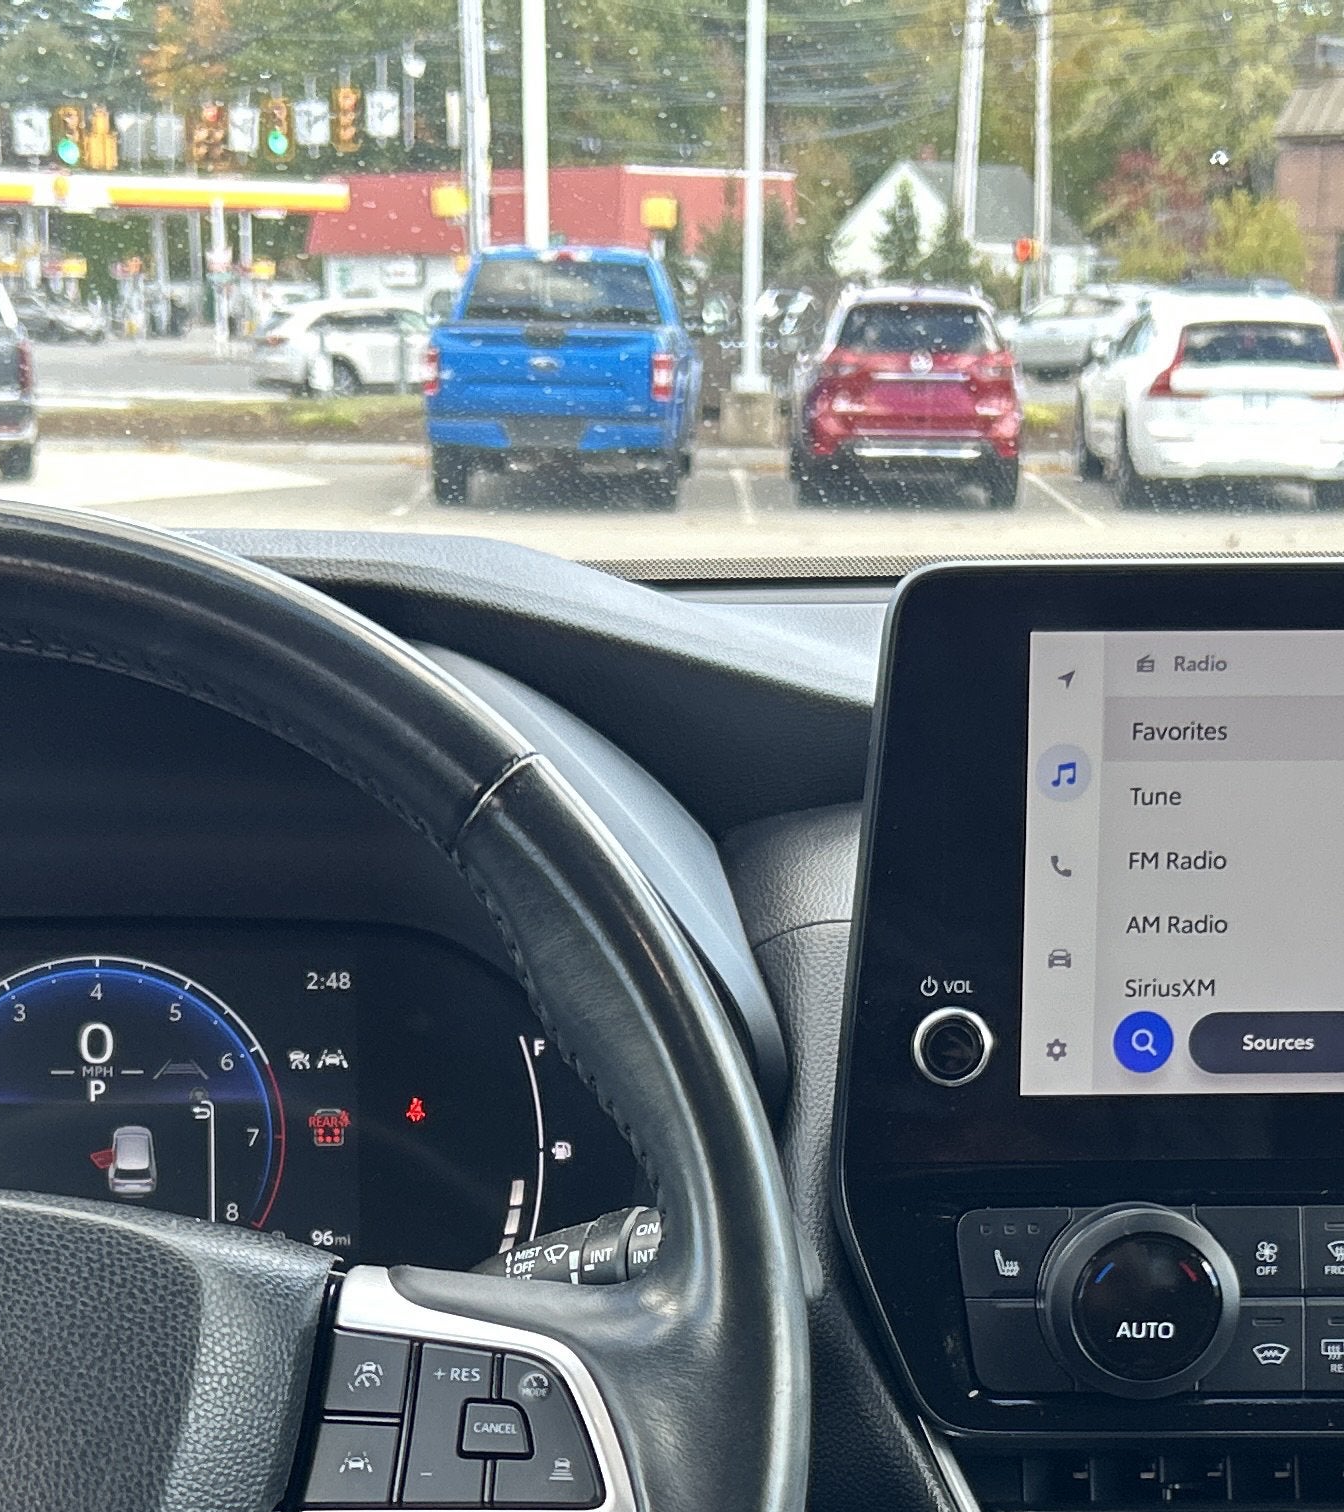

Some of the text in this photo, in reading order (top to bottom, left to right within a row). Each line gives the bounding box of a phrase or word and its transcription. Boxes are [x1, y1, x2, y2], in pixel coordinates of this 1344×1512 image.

[1173, 655, 1228, 672] Radio
[1131, 721, 1229, 742] Favorites
[1129, 787, 1183, 807] Tune
[1128, 851, 1228, 870] FM Radio
[1125, 914, 1229, 935] AM Radio
[305, 971, 352, 991] 2:48
[943, 979, 975, 994] VOL
[1123, 978, 1216, 999] SiriusXM
[89, 983, 103, 1001] 4
[12, 1003, 26, 1023] 3
[168, 1003, 182, 1022] 5
[533, 1039, 546, 1057] F
[1241, 1033, 1315, 1052] Sources
[81, 1065, 114, 1078] MPH
[220, 1052, 234, 1072] 6
[88, 1079, 107, 1102] P
[308, 1115, 338, 1129] REAR
[246, 1128, 260, 1147] 7
[224, 1202, 240, 1222] 8
[513, 1246, 543, 1261] MIST
[589, 1247, 614, 1264] INT
[632, 1248, 657, 1265] INT
[513, 1260, 536, 1274] OFF
[1255, 1265, 1278, 1276] OFF
[1115, 1321, 1176, 1340] AUTO
[449, 1367, 482, 1383] RES
[472, 1421, 518, 1435] CANCEL
